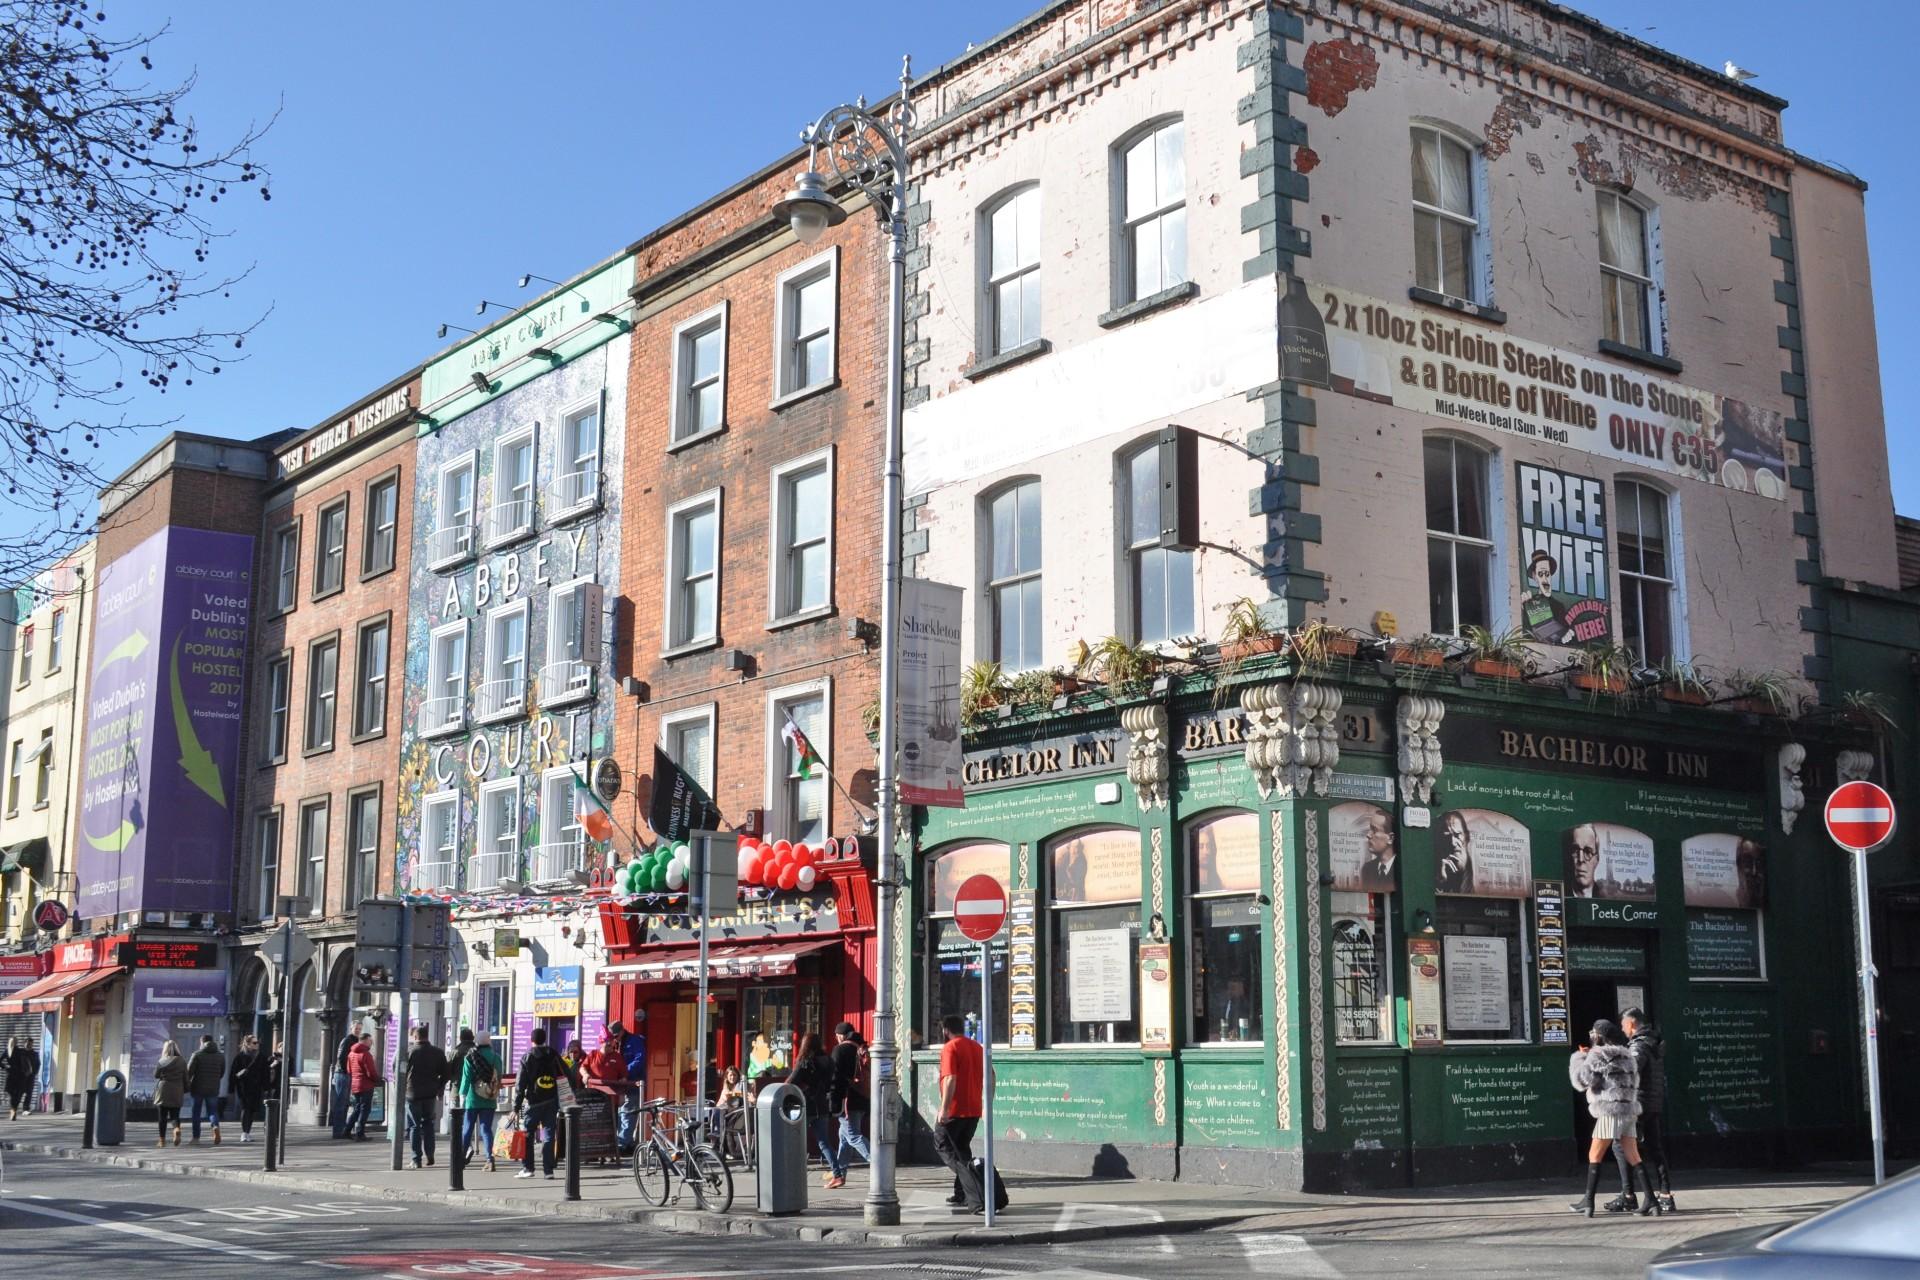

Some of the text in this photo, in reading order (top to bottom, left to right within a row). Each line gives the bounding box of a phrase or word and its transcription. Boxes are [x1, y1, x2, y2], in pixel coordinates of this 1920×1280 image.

[1283, 344, 1327, 360] Bachelor
[1324, 292, 1703, 424] 2 x 10oz Sirloin Steaks on the Stone
[1401, 355, 1597, 430] & a Bottle of Wine
[309, 420, 349, 462] CHURCH
[354, 386, 410, 437] MISSIONS
[1436, 399, 1487, 423] Mid-Week
[1489, 412, 1512, 430] Deal
[1513, 417, 1536, 436] (Sun
[1543, 426, 1568, 443] Wed)
[1609, 413, 1718, 474] ONLY €35
[1520, 465, 1604, 539] FREE
[1521, 527, 1606, 600] WiFi
[175, 565, 233, 579] abbey court
[443, 527, 586, 618] ABBEY
[204, 593, 247, 609] Voted
[191, 608, 246, 625] Dublin's
[1564, 600, 1609, 625] AVAILABLE
[205, 627, 245, 641] MOST
[903, 615, 960, 641] Shackleton
[1574, 617, 1608, 642] HERE!
[184, 643, 243, 659] POPULAR
[902, 649, 927, 660] Project
[192, 662, 242, 678] HOSTEL
[209, 682, 241, 695] 2017
[93, 677, 146, 721] Voted Dublin's
[227, 700, 238, 709] by
[193, 709, 240, 720] Hostelworld
[1184, 717, 1243, 751] BAR
[1343, 714, 1376, 743] 31
[435, 709, 581, 785] COURT
[1068, 738, 1116, 769] INN
[1500, 730, 1709, 778] BACHELOR INN
[88, 749, 118, 780] HOSTEL
[1194, 791, 1206, 801] Rich
[1447, 780, 1560, 800] Lack of money is the root of all
[84, 789, 94, 812] by
[1018, 790, 1078, 807] suffered from the night
[1591, 903, 1658, 922] Poets Corner
[1690, 921, 1735, 931] The Bachelor
[535, 1002, 554, 1013] OPEN
[1353, 1010, 1379, 1019] SERVED
[1445, 1064, 1461, 1076] Frail
[1462, 1065, 1473, 1074] the
[1474, 1064, 1490, 1074] white
[1506, 1064, 1518, 1073] and
[1519, 1063, 1532, 1073] frail
[1010, 1079, 1022, 1087] filled
[1023, 1082, 1030, 1090] my
[1030, 1080, 1042, 1090] days
[1042, 1080, 1052, 1088] with
[1186, 1080, 1209, 1091] Youth
[1210, 1081, 1216, 1090] is
[1223, 1080, 1258, 1091] wonderful
[1464, 1078, 1526, 1090] Her hands that gave
[1007, 1094, 1022, 1104] taught
[1029, 1096, 1050, 1104] ignorant
[1184, 1096, 1202, 1109] thing.
[1206, 1096, 1226, 1108] What
[1233, 1099, 1251, 1107] crime
[1253, 1099, 1261, 1107] to
[1451, 1093, 1474, 1104] Whose
[1475, 1092, 1489, 1103] soul
[1489, 1094, 1495, 1102] is
[1511, 1091, 1523, 1101] and
[999, 1109, 1010, 1118] upon
[1010, 1107, 1018, 1115] the
[1018, 1109, 1033, 1118] great,
[1034, 1108, 1044, 1117] had
[1045, 1109, 1056, 1119] they
[1055, 1109, 1065, 1117] but
[1087, 1111, 1101, 1120] equal
[1188, 1116, 1209, 1124] waste
[1209, 1115, 1215, 1124] it
[1227, 1113, 1256, 1125] children.
[1462, 1107, 1480, 1119] Than
[1481, 1108, 1500, 1117] time's
[206, 1200, 409, 1222] BUS
